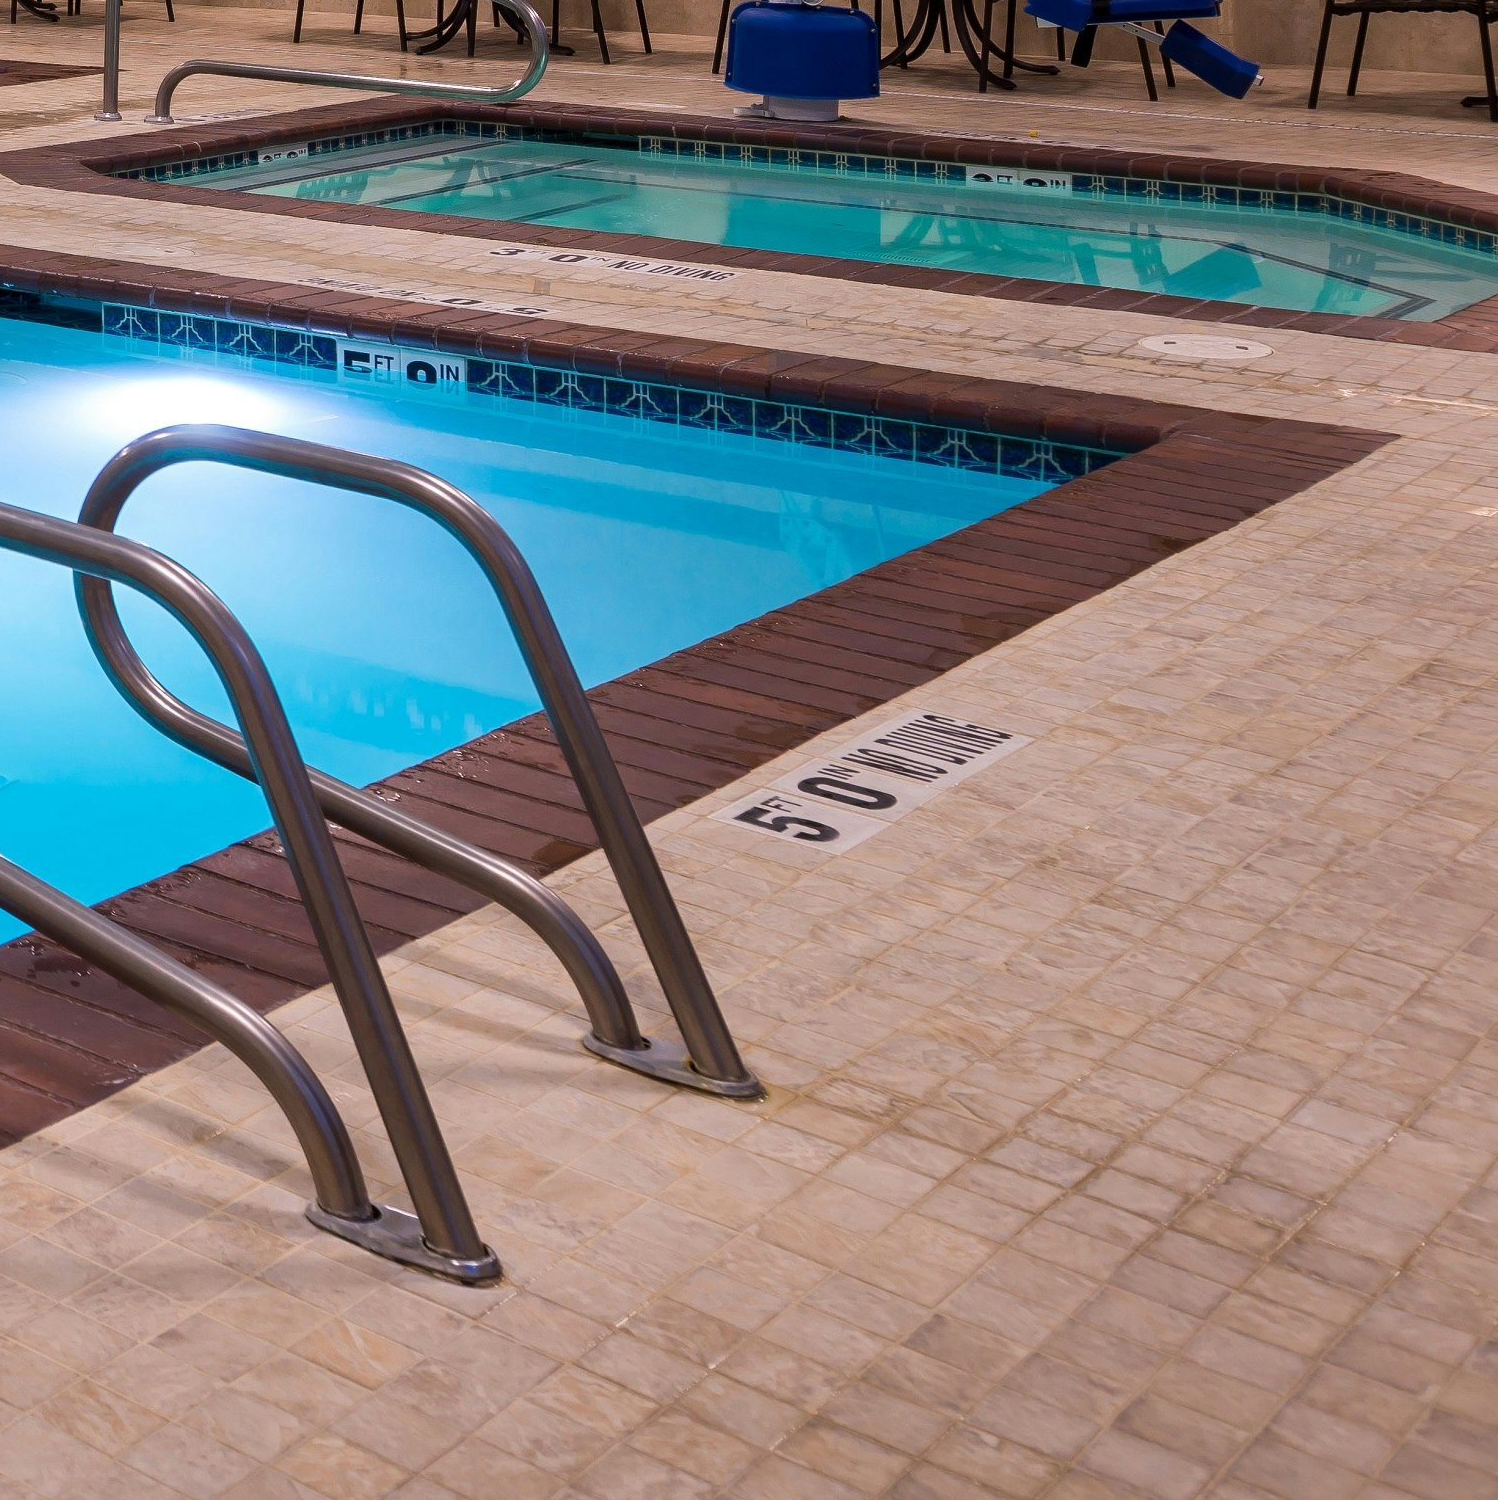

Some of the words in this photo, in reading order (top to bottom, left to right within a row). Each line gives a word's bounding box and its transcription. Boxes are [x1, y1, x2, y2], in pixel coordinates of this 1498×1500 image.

[490, 248, 525, 256] 3
[549, 254, 588, 263] 0
[608, 260, 650, 270] NO
[648, 265, 736, 281] DIVING
[344, 350, 372, 373] 5
[374, 354, 394, 371] FT
[407, 361, 437, 383] 0
[440, 363, 460, 381] IN
[873, 714, 1014, 766] DIVING
[817, 763, 860, 780] IN
[840, 748, 949, 783] NO
[760, 796, 802, 813] FT
[797, 776, 898, 810] 0
[733, 806, 841, 842] 5
